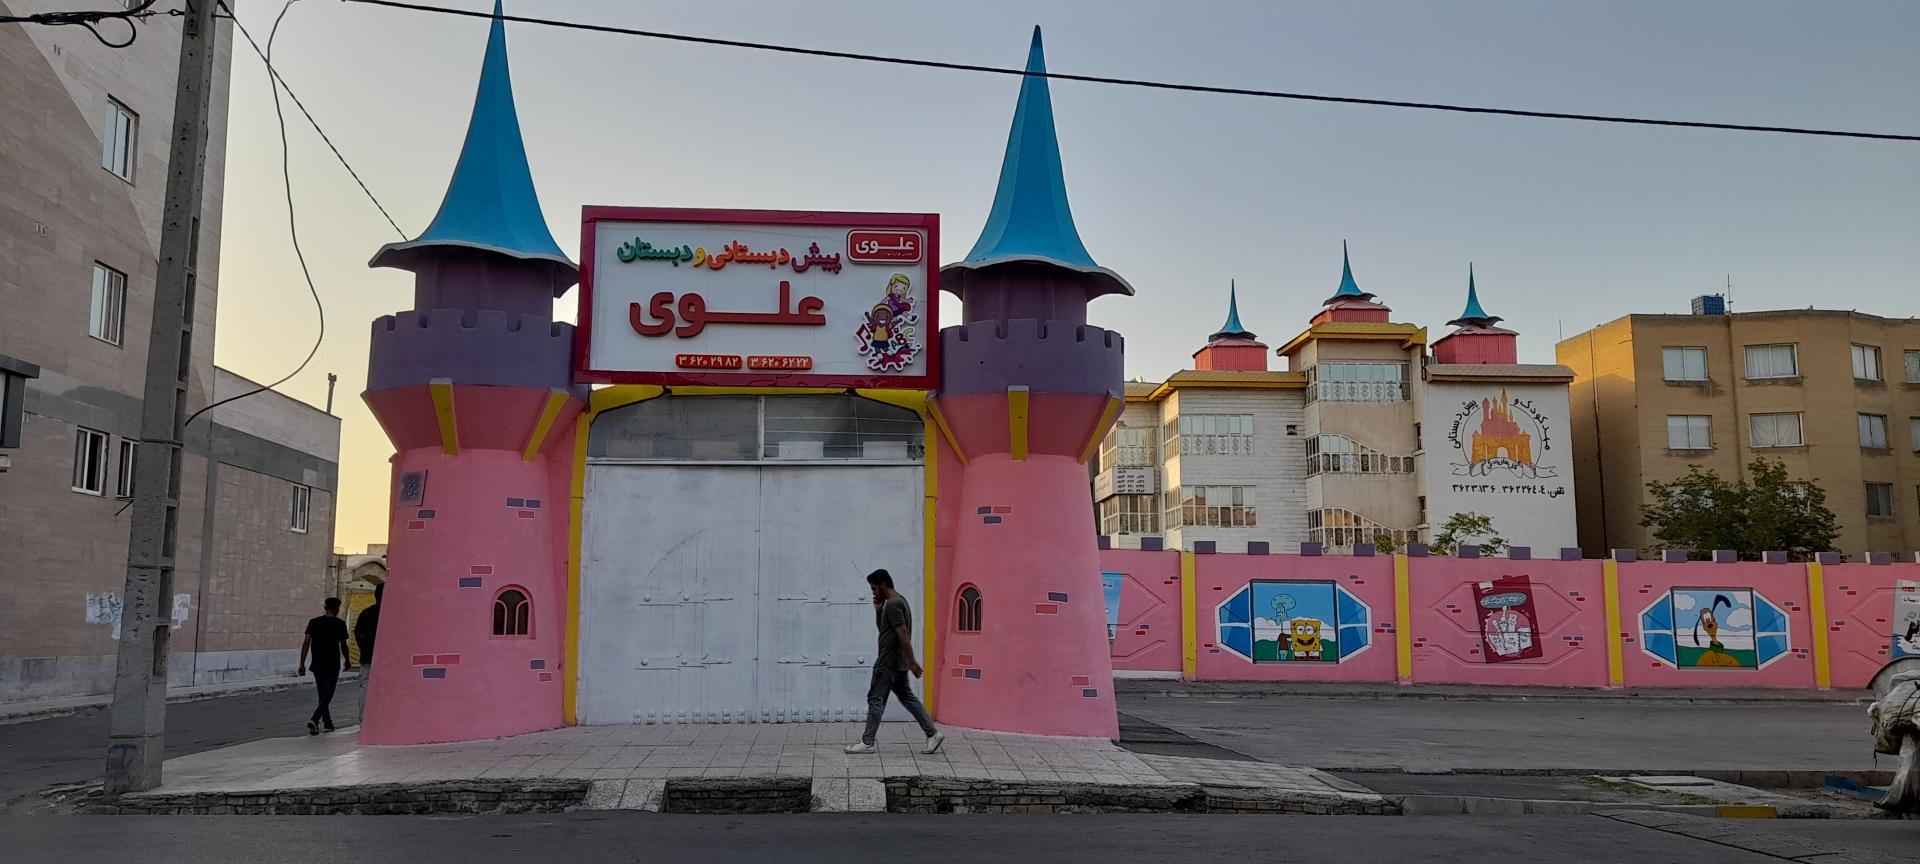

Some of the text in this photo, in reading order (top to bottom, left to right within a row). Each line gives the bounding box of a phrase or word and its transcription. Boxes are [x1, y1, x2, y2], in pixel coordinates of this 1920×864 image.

[617, 236, 843, 274] پیش دبستانی و دبستان
[855, 236, 915, 254] علوی
[629, 280, 827, 339] علوی
